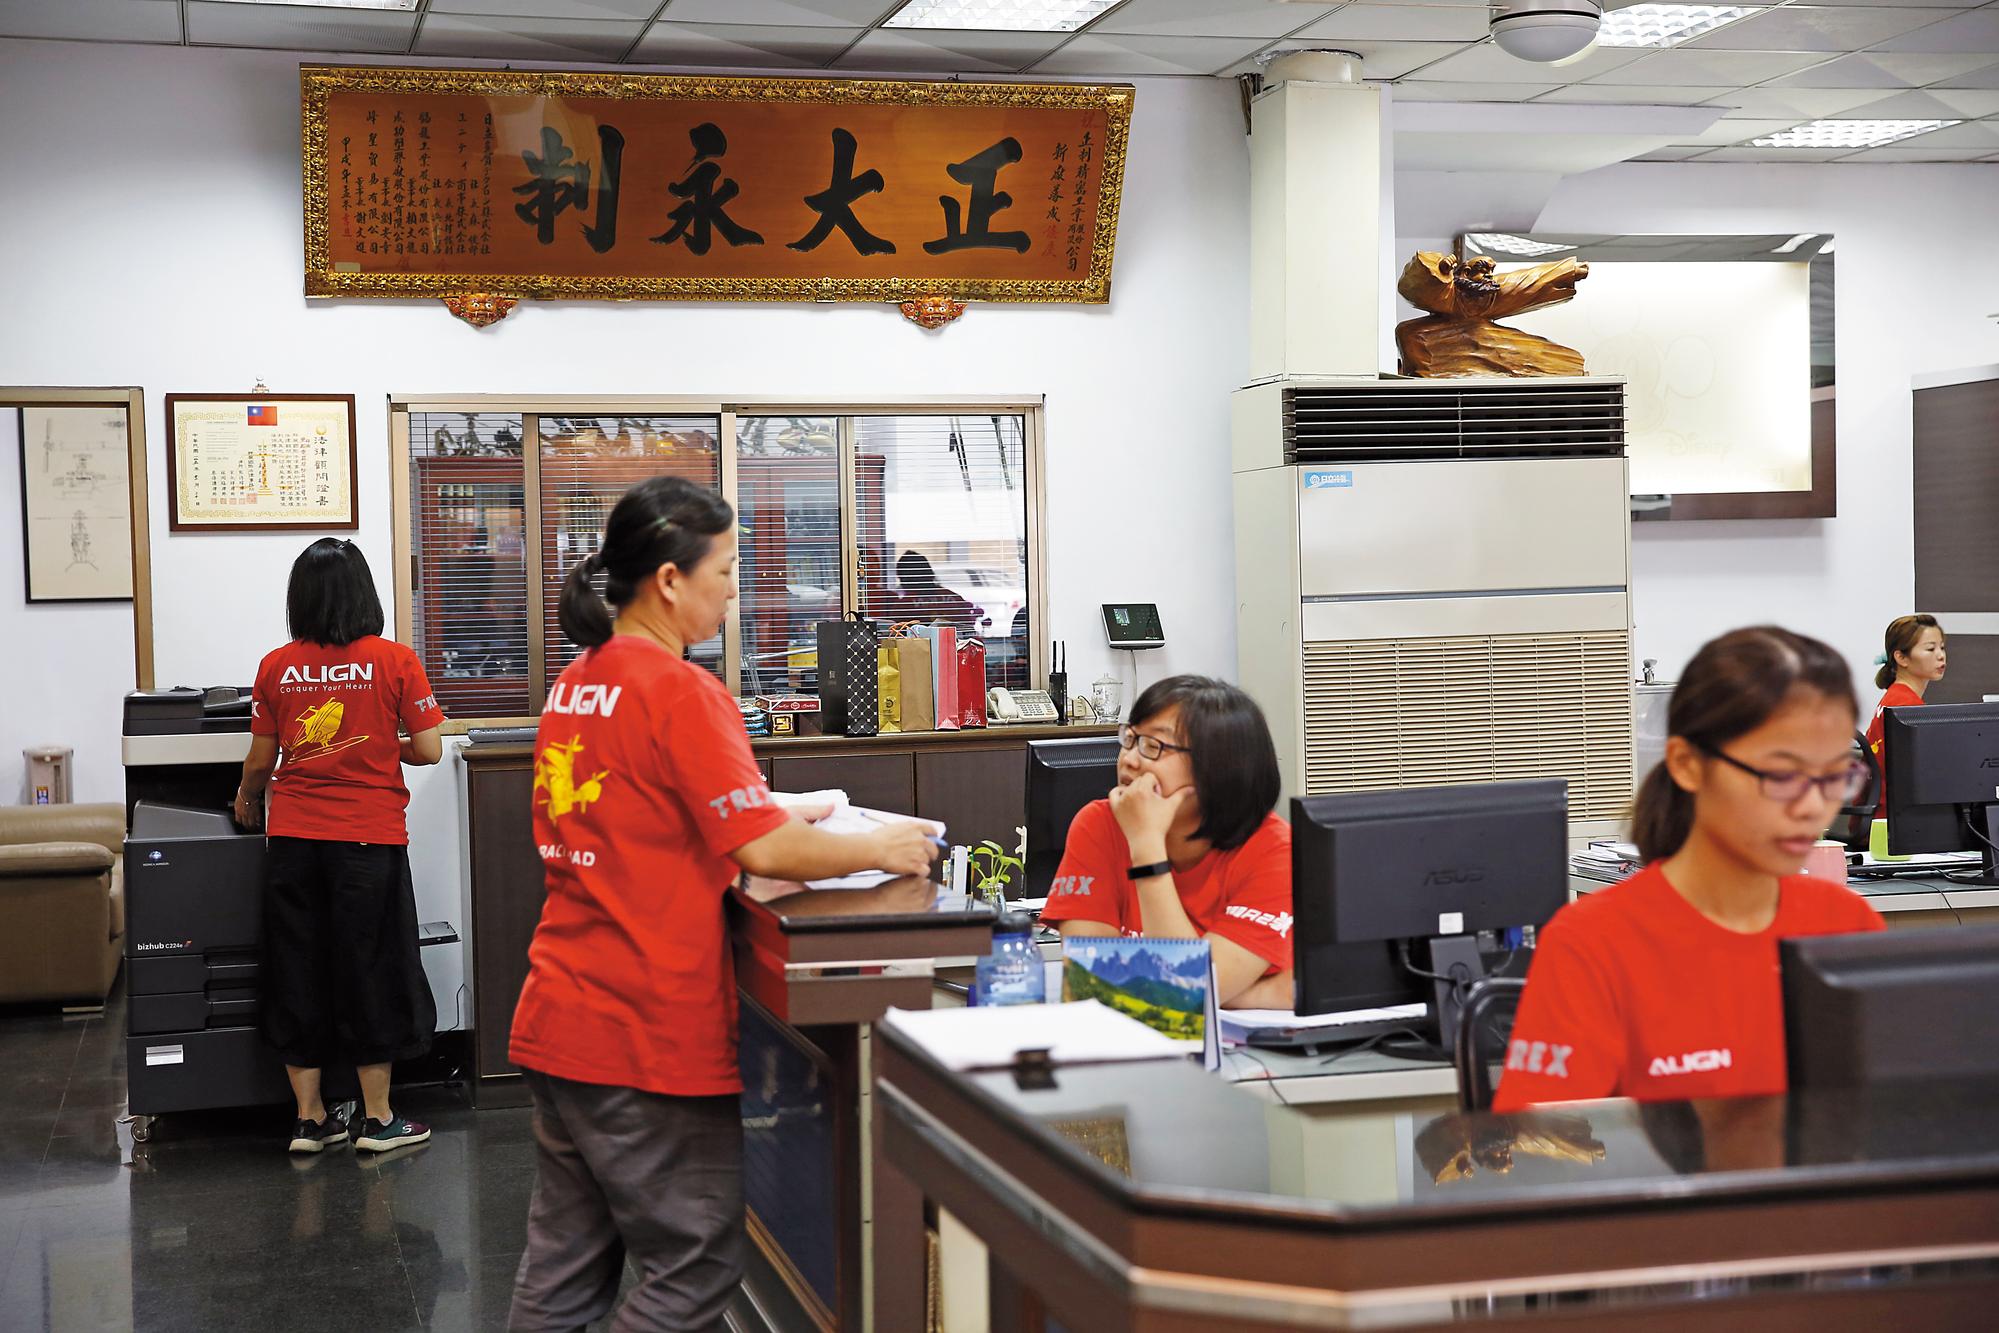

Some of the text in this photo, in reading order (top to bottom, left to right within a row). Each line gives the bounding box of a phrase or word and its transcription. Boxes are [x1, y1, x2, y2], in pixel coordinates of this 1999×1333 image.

[280, 663, 373, 684] ALIGN
[322, 684, 341, 692] Your
[345, 682, 372, 691] Heart
[1423, 868, 1486, 886] ASUS
[137, 942, 165, 950] bizhub
[1648, 1049, 1732, 1076] ALIGN
